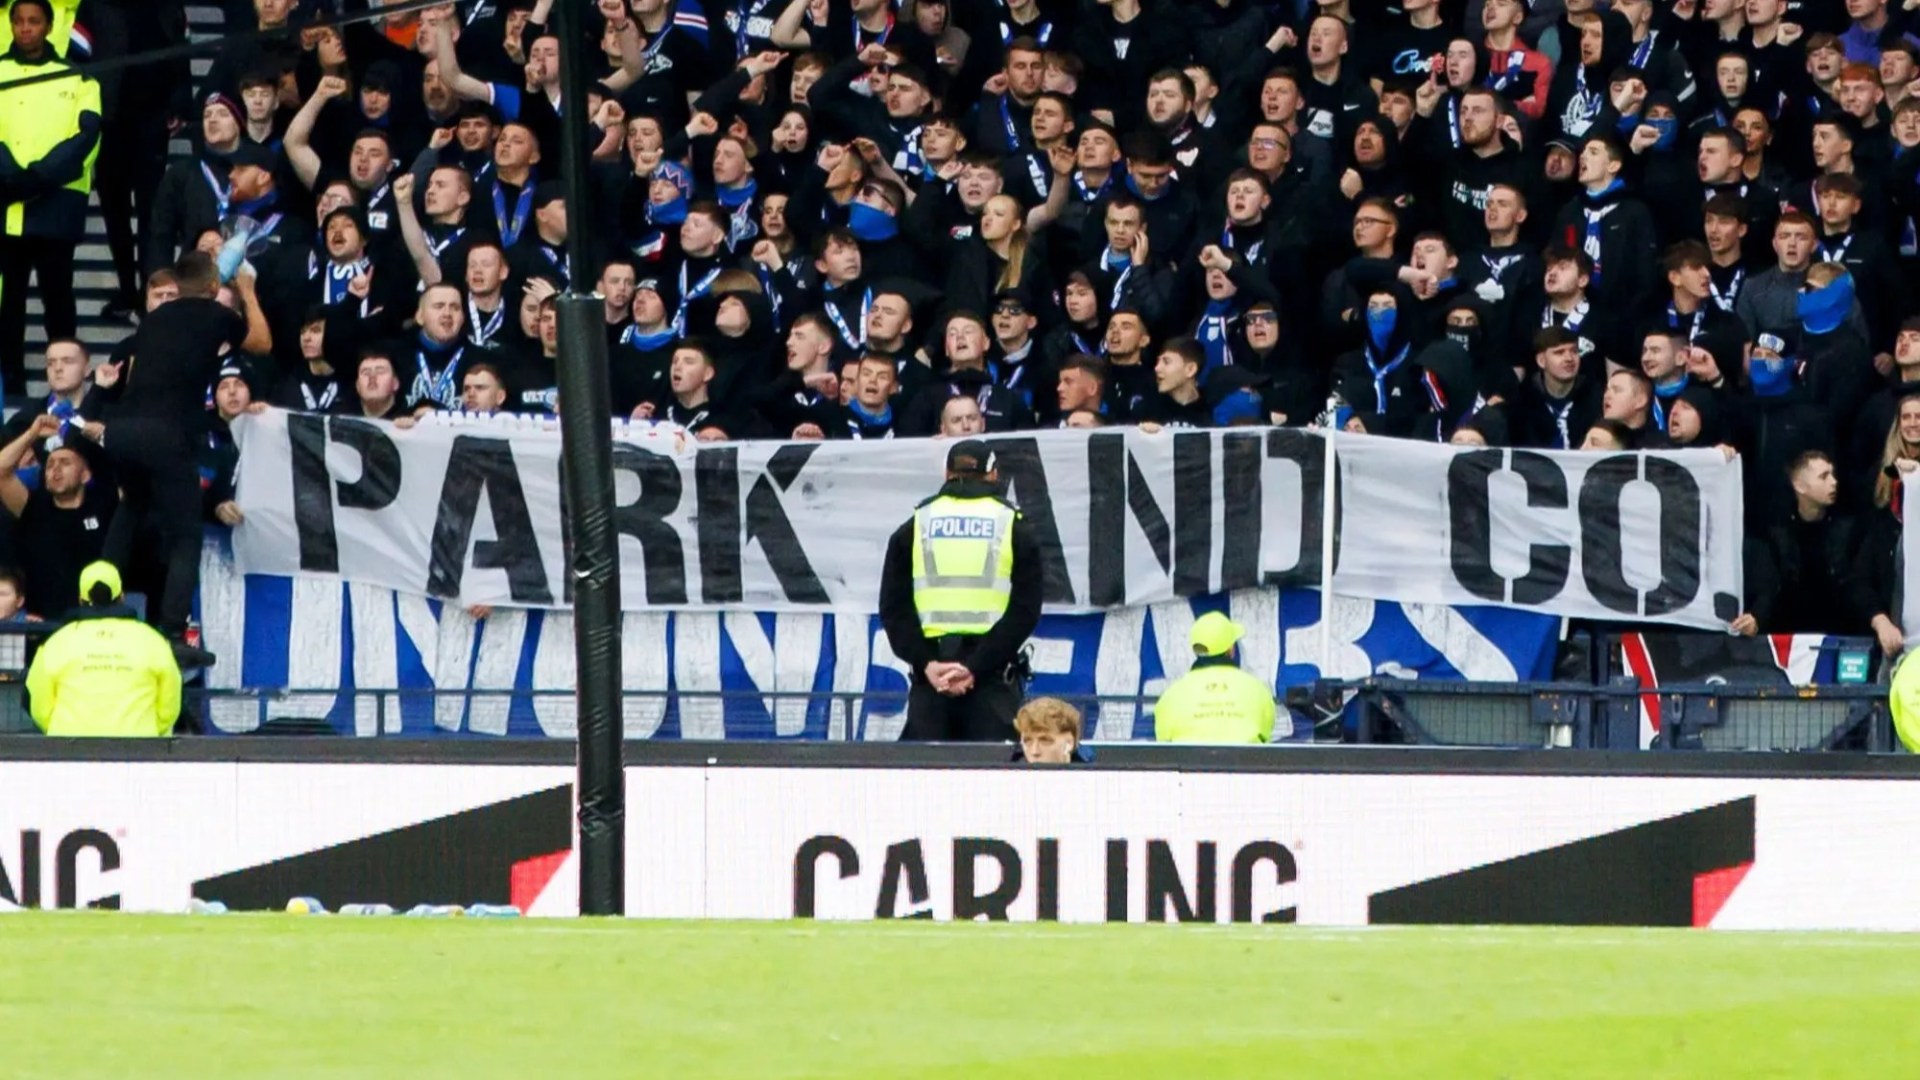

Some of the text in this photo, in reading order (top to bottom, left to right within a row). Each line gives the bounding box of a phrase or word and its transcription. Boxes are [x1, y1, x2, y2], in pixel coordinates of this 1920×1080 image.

[287, 412, 832, 605] PARK
[1448, 448, 1739, 623] CO.
[931, 518, 993, 537] POLICE
[793, 834, 1297, 922] CARLING
